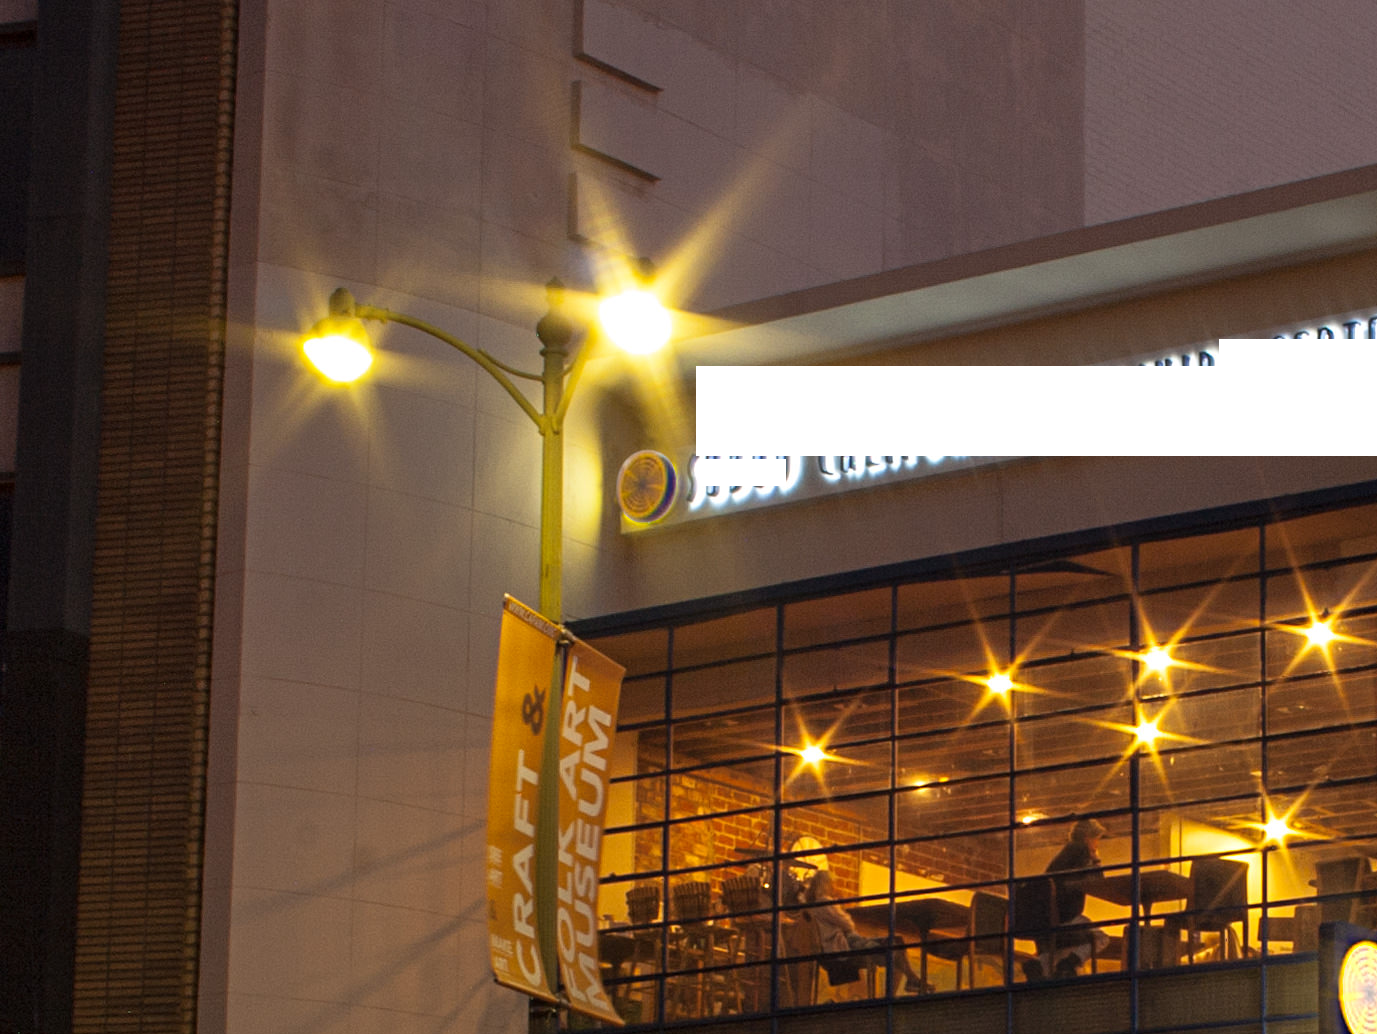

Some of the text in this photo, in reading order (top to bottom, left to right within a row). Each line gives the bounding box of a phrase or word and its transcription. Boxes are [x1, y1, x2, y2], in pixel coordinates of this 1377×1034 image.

[513, 684, 546, 986] CRAFT &
[557, 656, 590, 1003] FOLK ART
[574, 705, 612, 1011] MUSEUM
